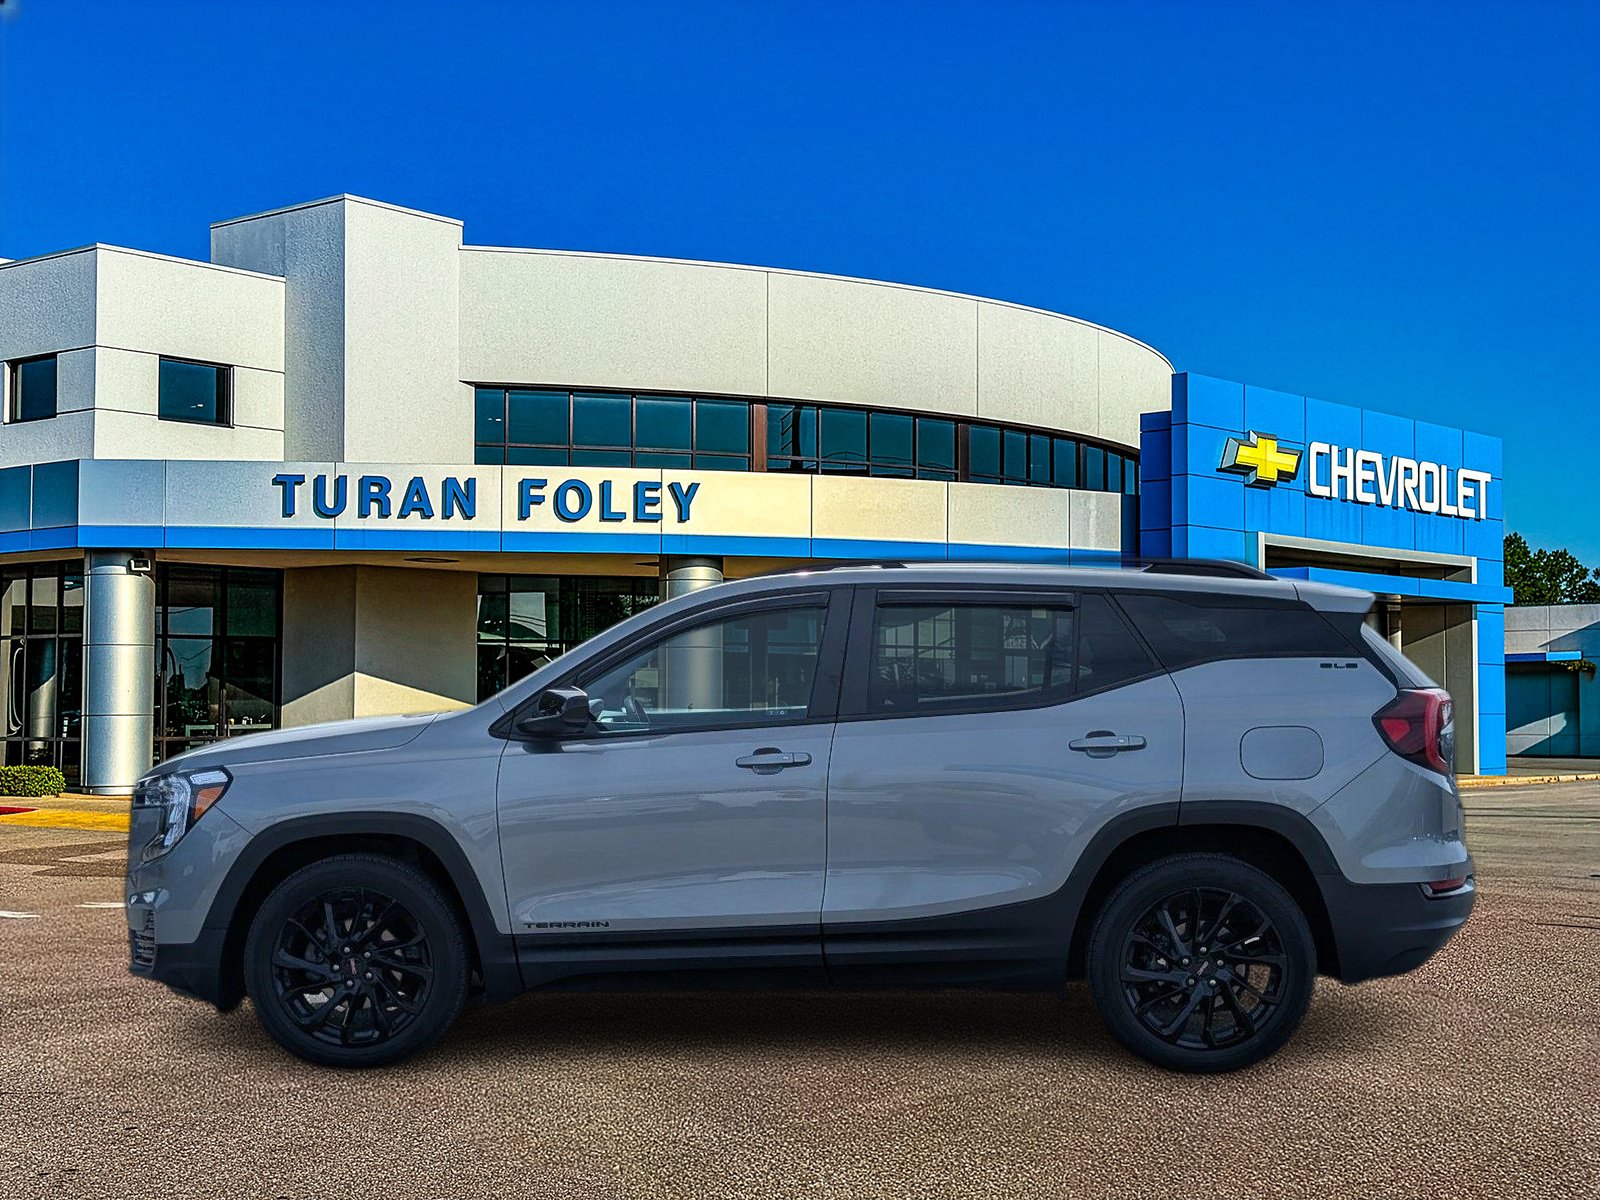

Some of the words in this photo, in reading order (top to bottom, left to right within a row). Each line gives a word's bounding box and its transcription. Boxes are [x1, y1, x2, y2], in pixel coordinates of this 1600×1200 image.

[271, 473, 477, 521] TURAN
[517, 477, 701, 524] FOLEY
[1306, 440, 1492, 521] CHEVROLET
[523, 921, 610, 929] TERRAIN
